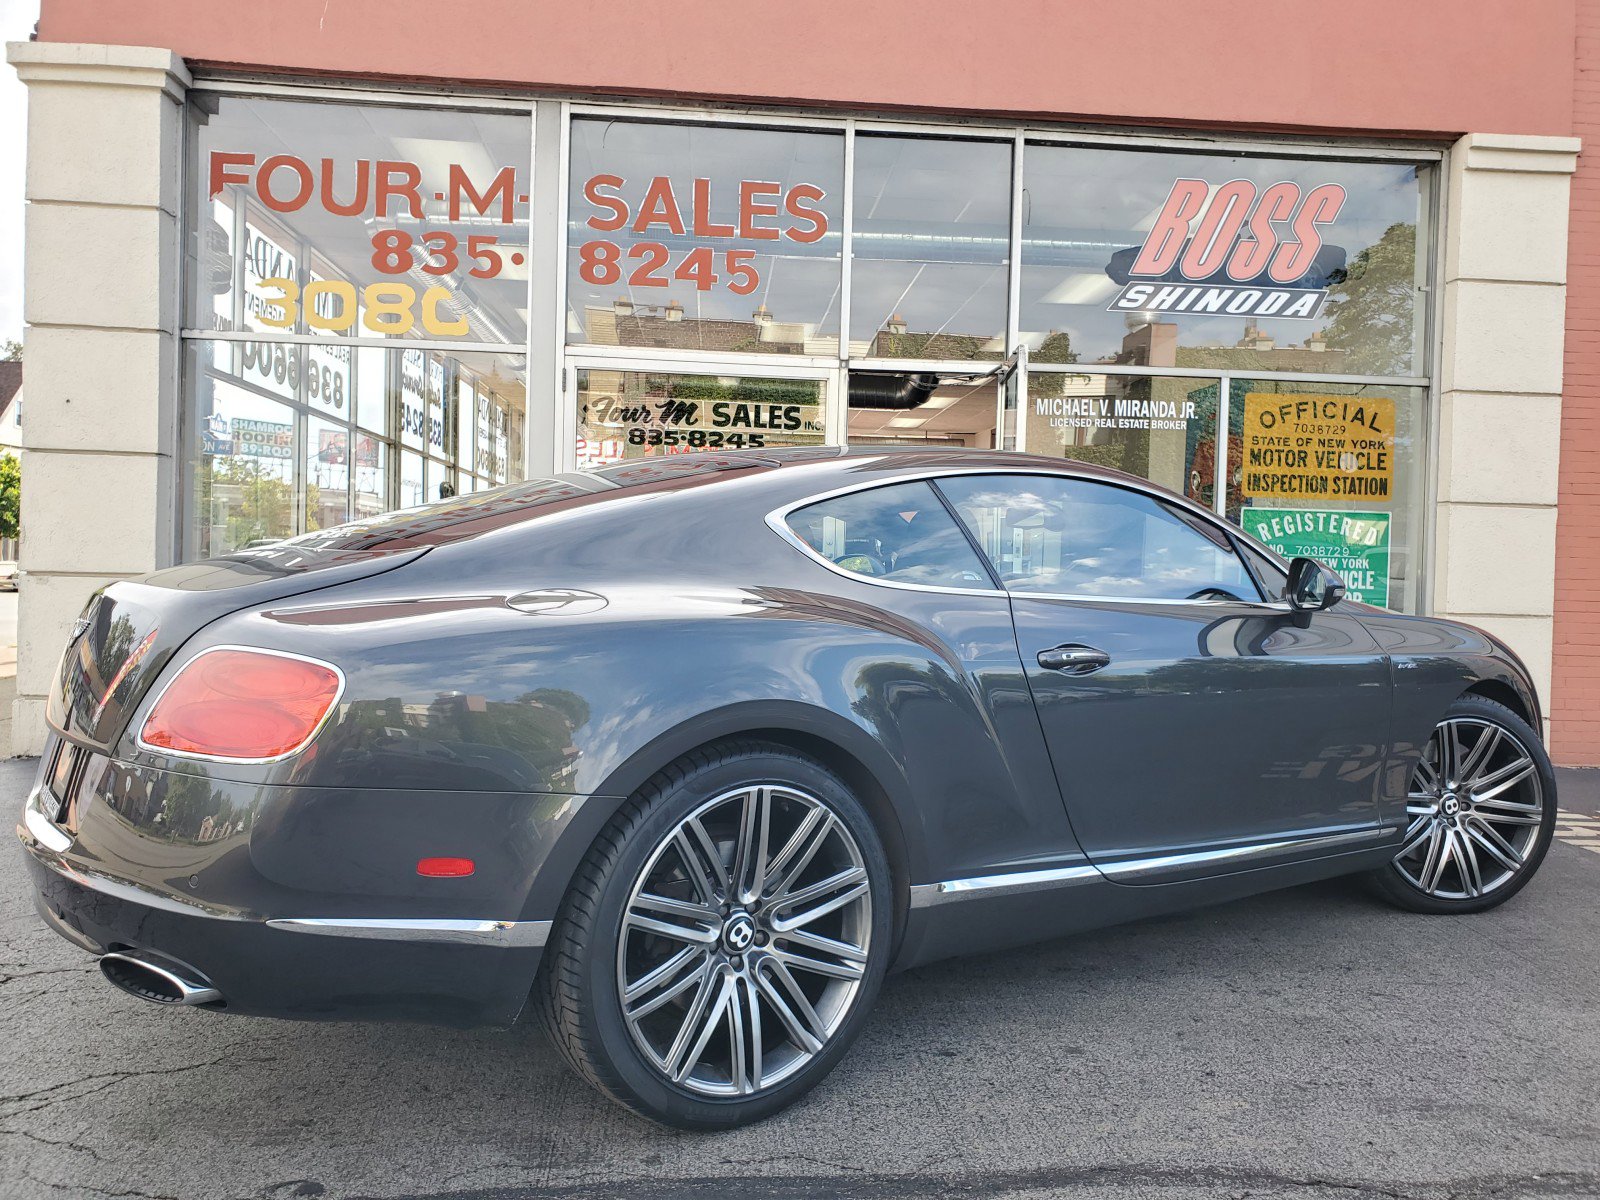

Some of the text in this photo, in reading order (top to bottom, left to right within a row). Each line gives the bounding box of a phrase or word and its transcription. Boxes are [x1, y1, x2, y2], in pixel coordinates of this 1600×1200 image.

[209, 151, 426, 220] FOUR
[582, 173, 829, 243] SALES
[1128, 177, 1348, 284] BOSS
[578, 240, 761, 295] 8245
[1117, 284, 1319, 318] SHINODA
[592, 396, 653, 425] Four
[712, 402, 802, 431] SALES
[804, 420, 824, 432] INC.
[1036, 398, 1199, 419] MICHAEL V. MIRANDA JR.
[1259, 400, 1382, 434] OFFICIAL
[231, 418, 293, 434] SHAMROC
[1050, 417, 1187, 430] LICENSED REAL ESTATE BROKER
[1251, 435, 1386, 450] STATE OF NEW YORK
[1250, 448, 1308, 468] MOTOR
[1247, 473, 1388, 496] INSPECTION STATION
[1256, 512, 1378, 545] REGISTERED
[1342, 559, 1369, 569] YORK
